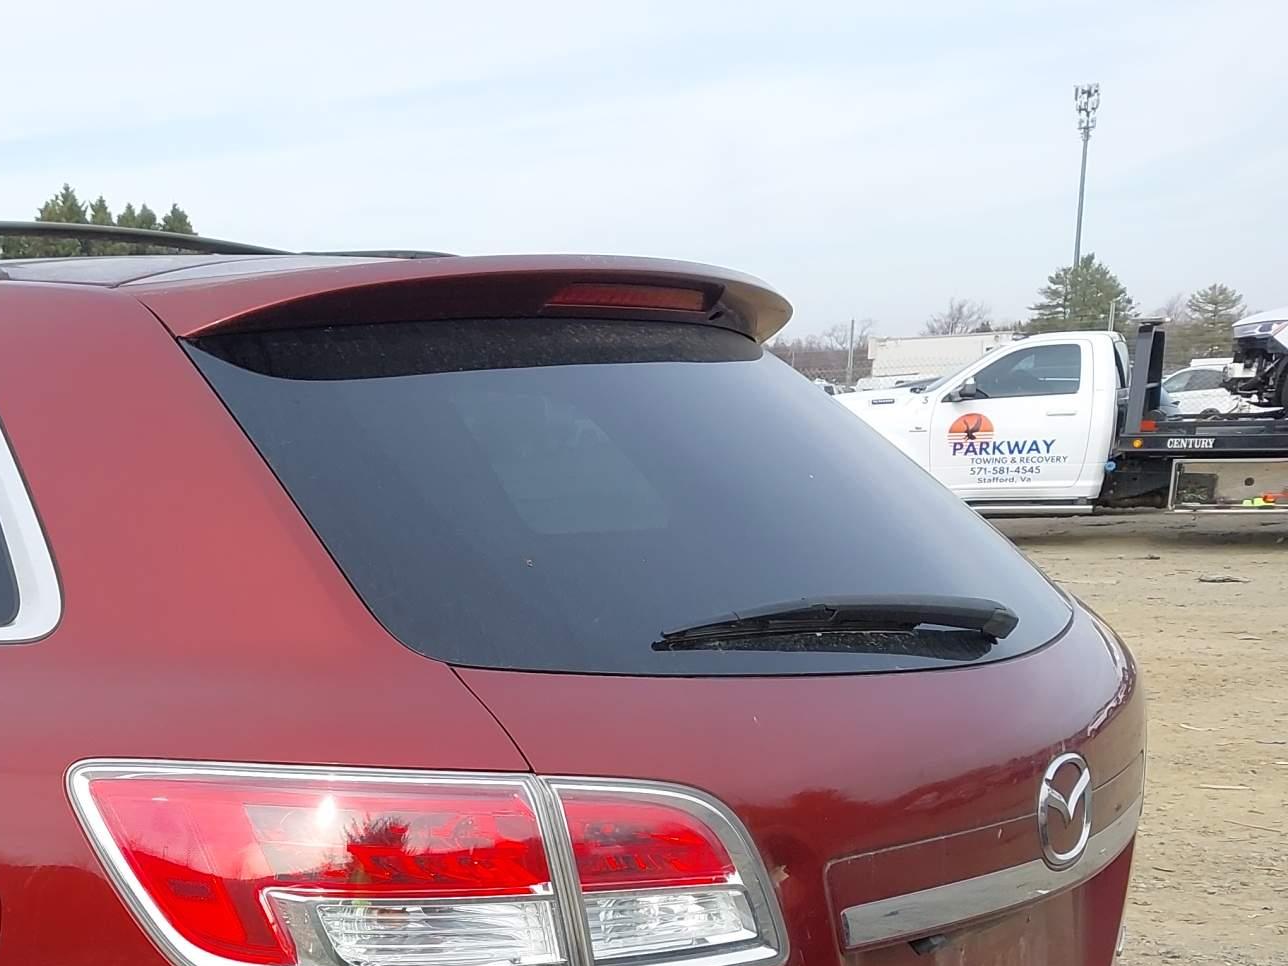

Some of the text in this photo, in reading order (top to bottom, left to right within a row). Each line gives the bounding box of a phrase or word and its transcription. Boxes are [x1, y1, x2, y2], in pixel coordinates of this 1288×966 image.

[952, 439, 1056, 456] PARKWAY
[1167, 437, 1216, 449] CENTURY
[970, 455, 1069, 465] TOWING & RECOVERY
[969, 465, 1041, 475] 571-581-4545
[977, 476, 1017, 484] Stafford,
